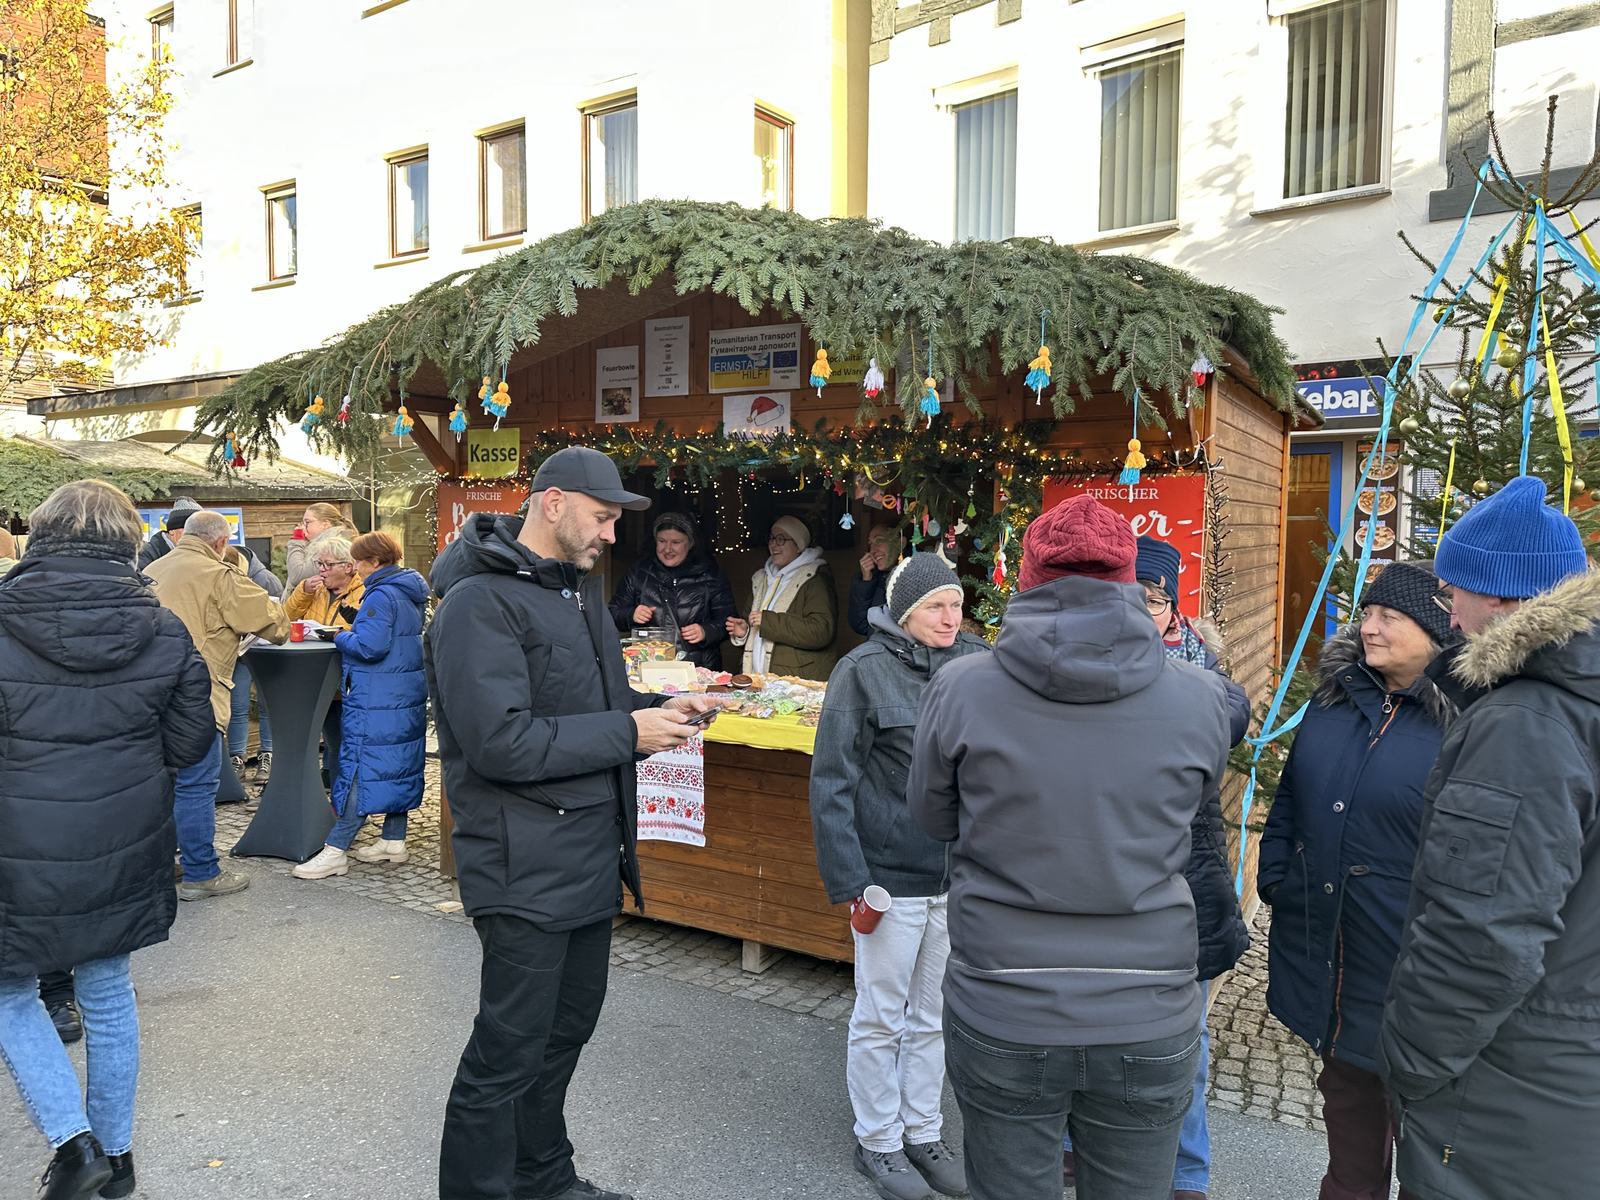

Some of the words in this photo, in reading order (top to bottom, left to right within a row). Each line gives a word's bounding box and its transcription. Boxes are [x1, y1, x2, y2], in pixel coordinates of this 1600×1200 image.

[710, 335, 758, 345] Humanitarian
[760, 331, 796, 341] Transport
[710, 345, 757, 355] Гуманітарна
[758, 341, 796, 351] допомога
[602, 364, 636, 373] Feuerbowle
[742, 369, 768, 379] HILFT
[1297, 384, 1377, 414] ebap
[470, 444, 517, 462] Kasse
[466, 491, 502, 500] FRISCHE
[1086, 487, 1160, 500] FRISCHER
